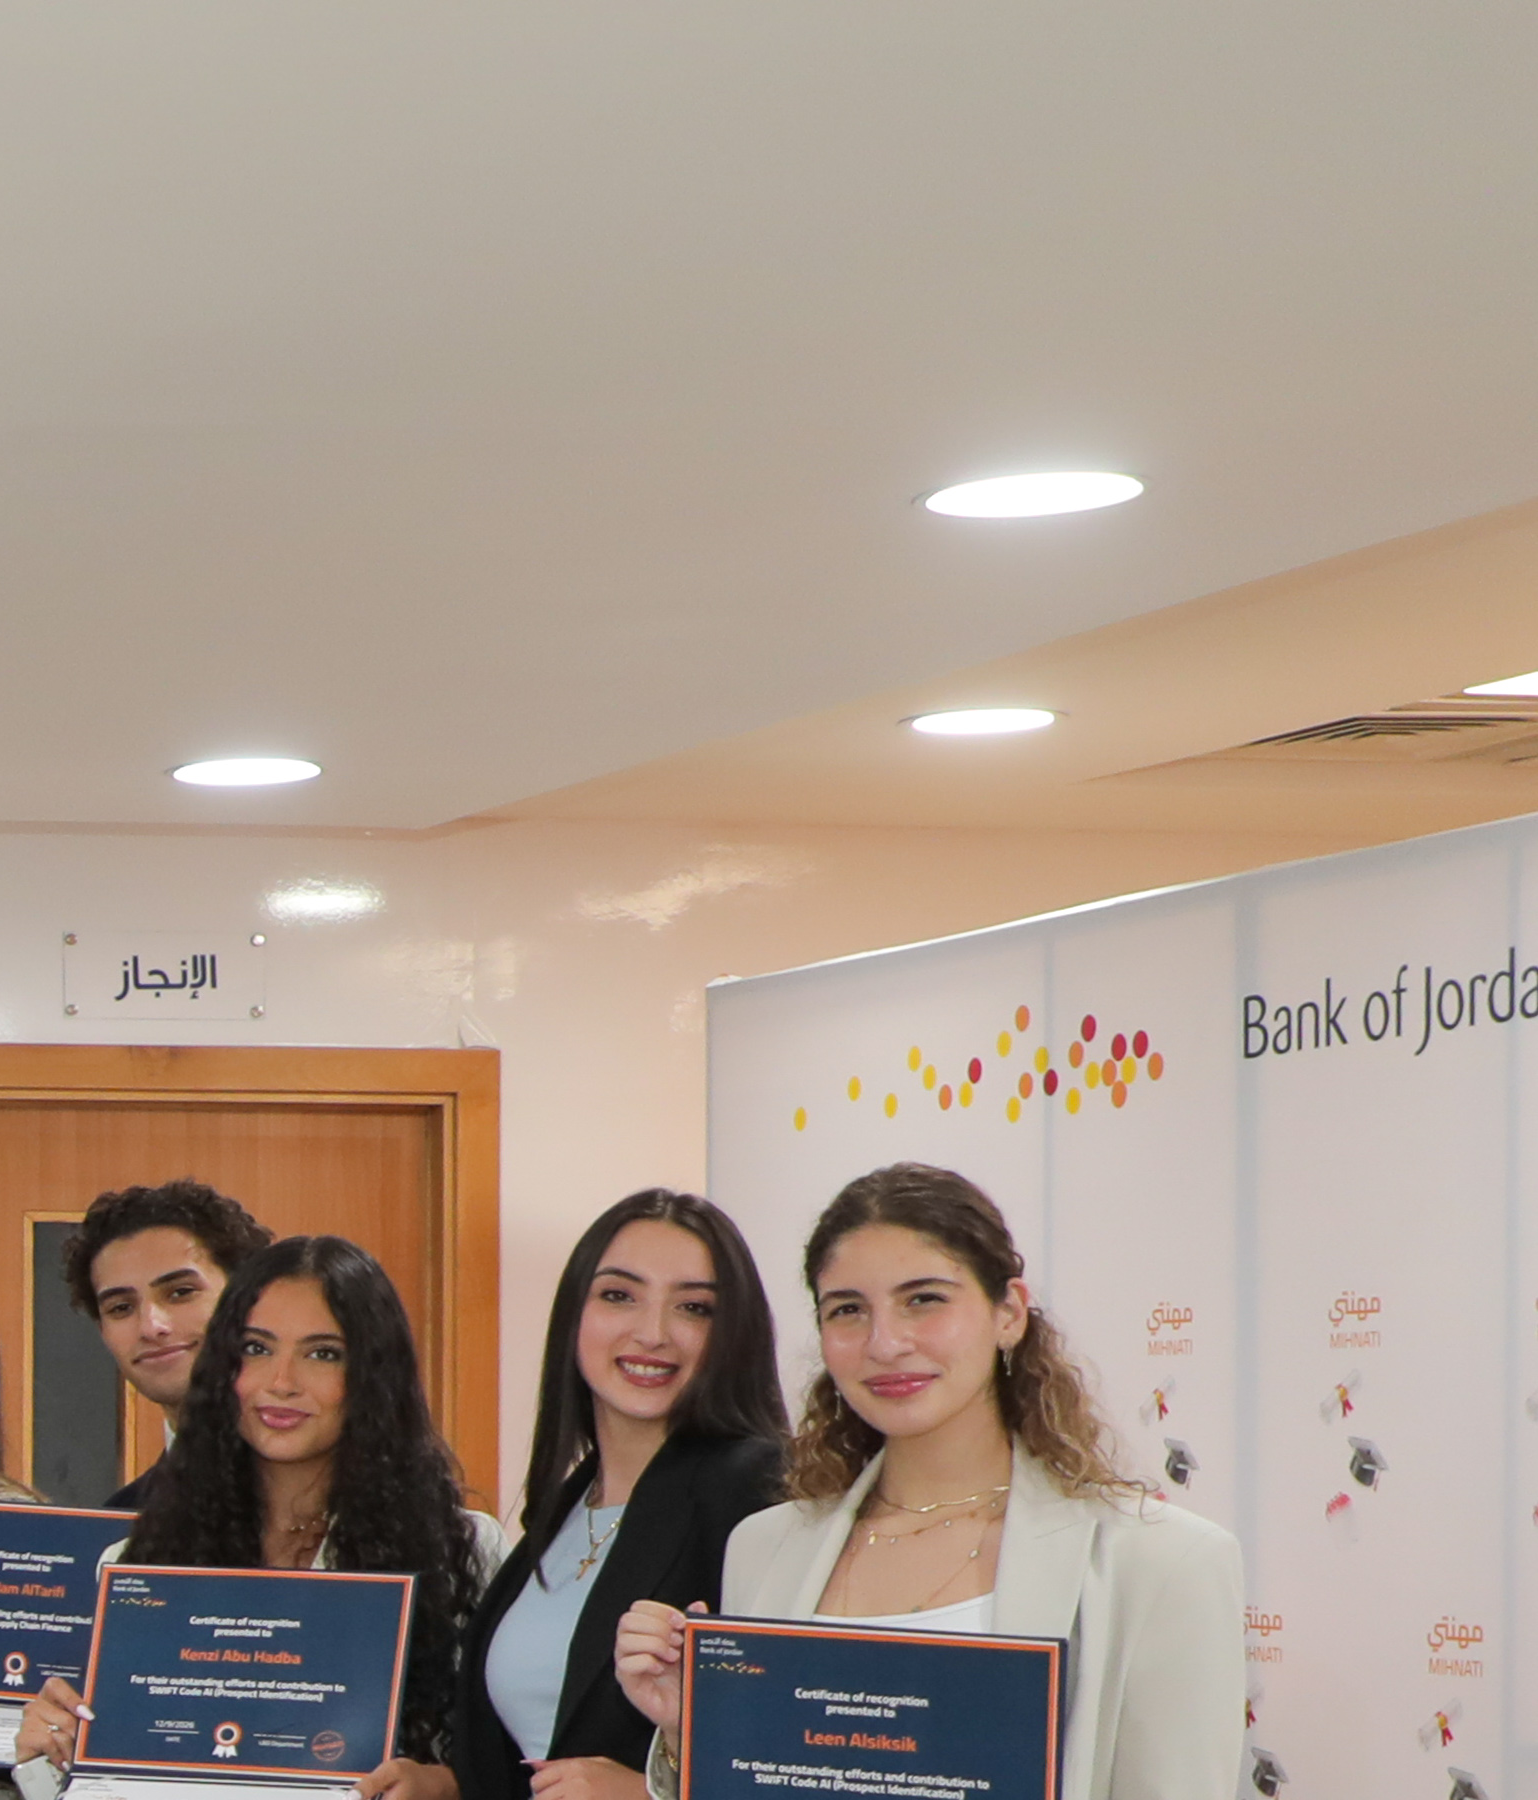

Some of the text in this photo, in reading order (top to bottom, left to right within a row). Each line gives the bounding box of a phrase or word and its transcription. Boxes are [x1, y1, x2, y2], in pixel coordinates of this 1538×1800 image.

[114, 954, 218, 1001] الإنجاز
[1244, 946, 1538, 1059] Bank of Jorda
[1146, 1301, 1194, 1336] مهنتي
[1329, 1290, 1381, 1328] مهنتي
[1147, 1338, 1194, 1356] MIHNATI
[1329, 1330, 1381, 1349] MIHNATI
[20, 1552, 31, 1560] of
[30, 1554, 74, 1564] recognition
[189, 1616, 300, 1629] Certificate of recognition
[1244, 1606, 1283, 1637] مهنت
[214, 1628, 272, 1637] presented to
[1427, 1616, 1484, 1653] مهنتي
[180, 1648, 302, 1664] Kenzi Abu Hadba
[1244, 1645, 1283, 1663] IHNATI
[1428, 1657, 1484, 1678] MIHNATI
[130, 1675, 346, 1693] For their outstanding efforts and contribution to
[149, 1685, 178, 1695] SWIFT
[179, 1687, 202, 1696] Code
[214, 1688, 258, 1699] (Prospect
[795, 1688, 929, 1708] Certificate of recognition
[825, 1705, 896, 1718] presented to
[804, 1730, 916, 1752] Leen Alsiksik
[732, 1759, 990, 1790] For their outstanding efforts and contribution to
[755, 1773, 965, 1800] SWIFT Code AI (Prospect Identification)
